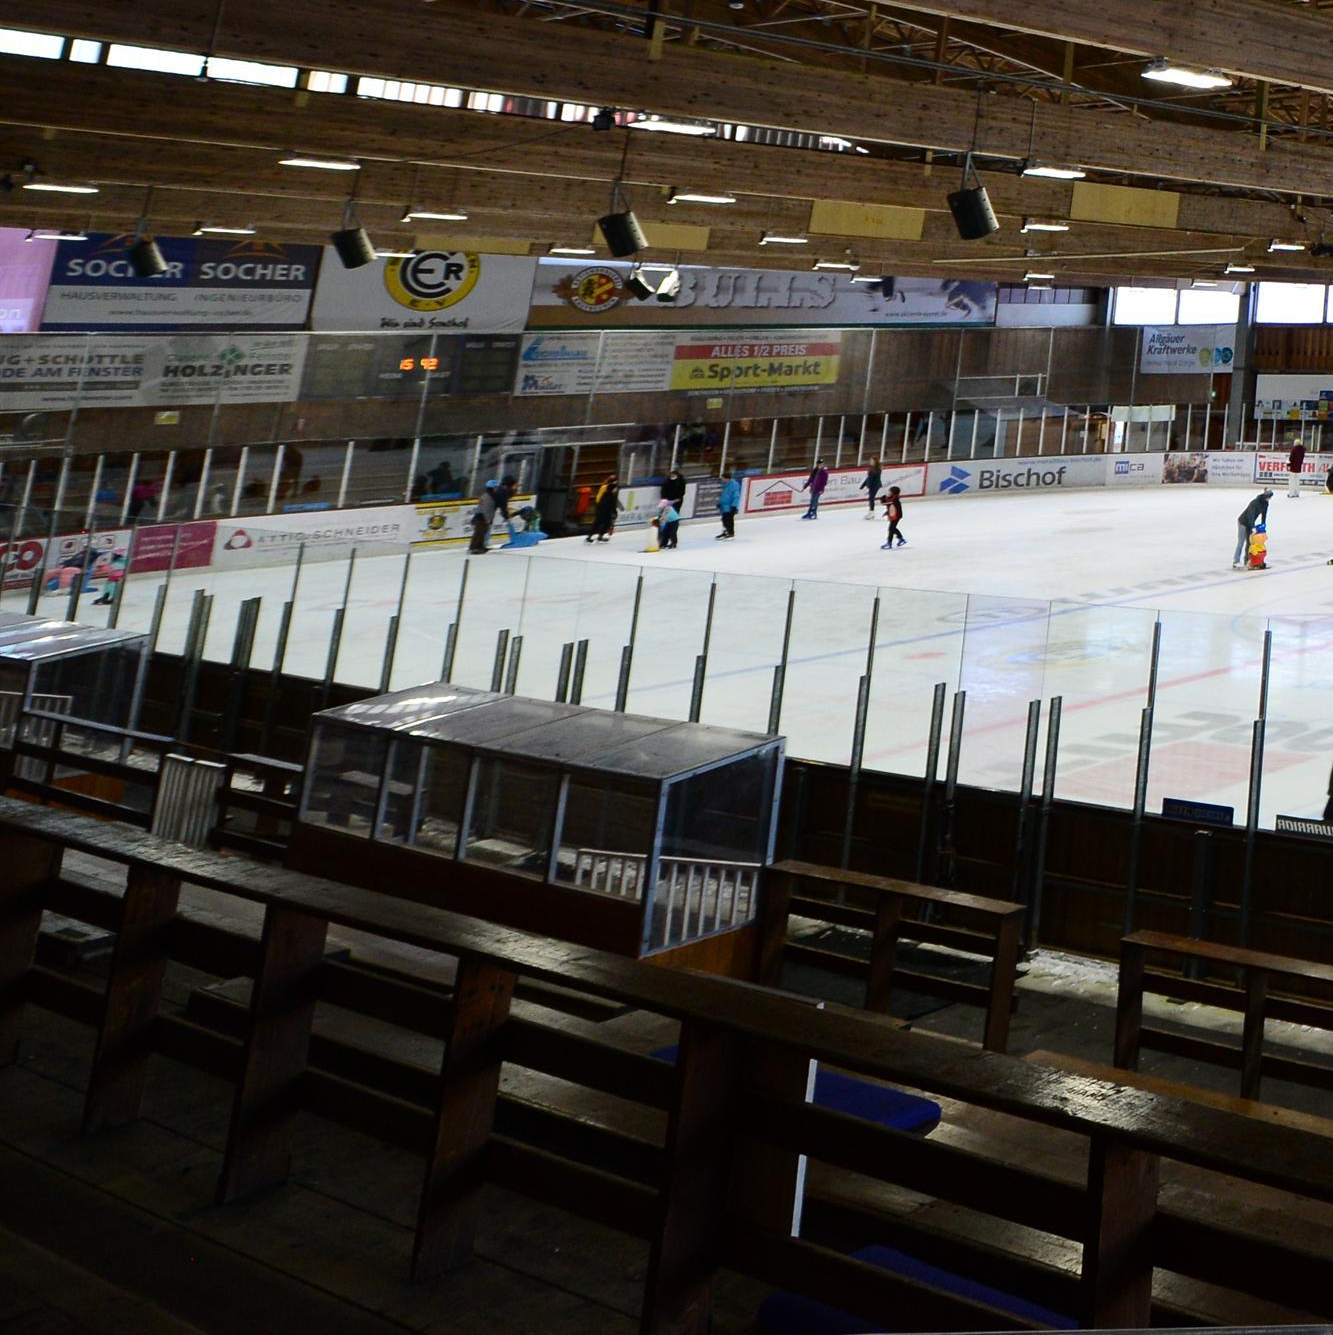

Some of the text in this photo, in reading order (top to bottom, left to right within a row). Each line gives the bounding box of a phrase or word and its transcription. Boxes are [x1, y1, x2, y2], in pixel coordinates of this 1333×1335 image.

[66, 259, 305, 281] SOCR SOCHER
[711, 344, 807, 358] ALLES 1/2 PREIS
[1146, 344, 1197, 356] Kraftwerke
[31, 367, 62, 378] AM
[67, 367, 143, 377] FENSTER
[163, 363, 292, 378] HOLZINGER
[707, 360, 821, 382] Sport-Markt
[978, 466, 1066, 490] Bischof
